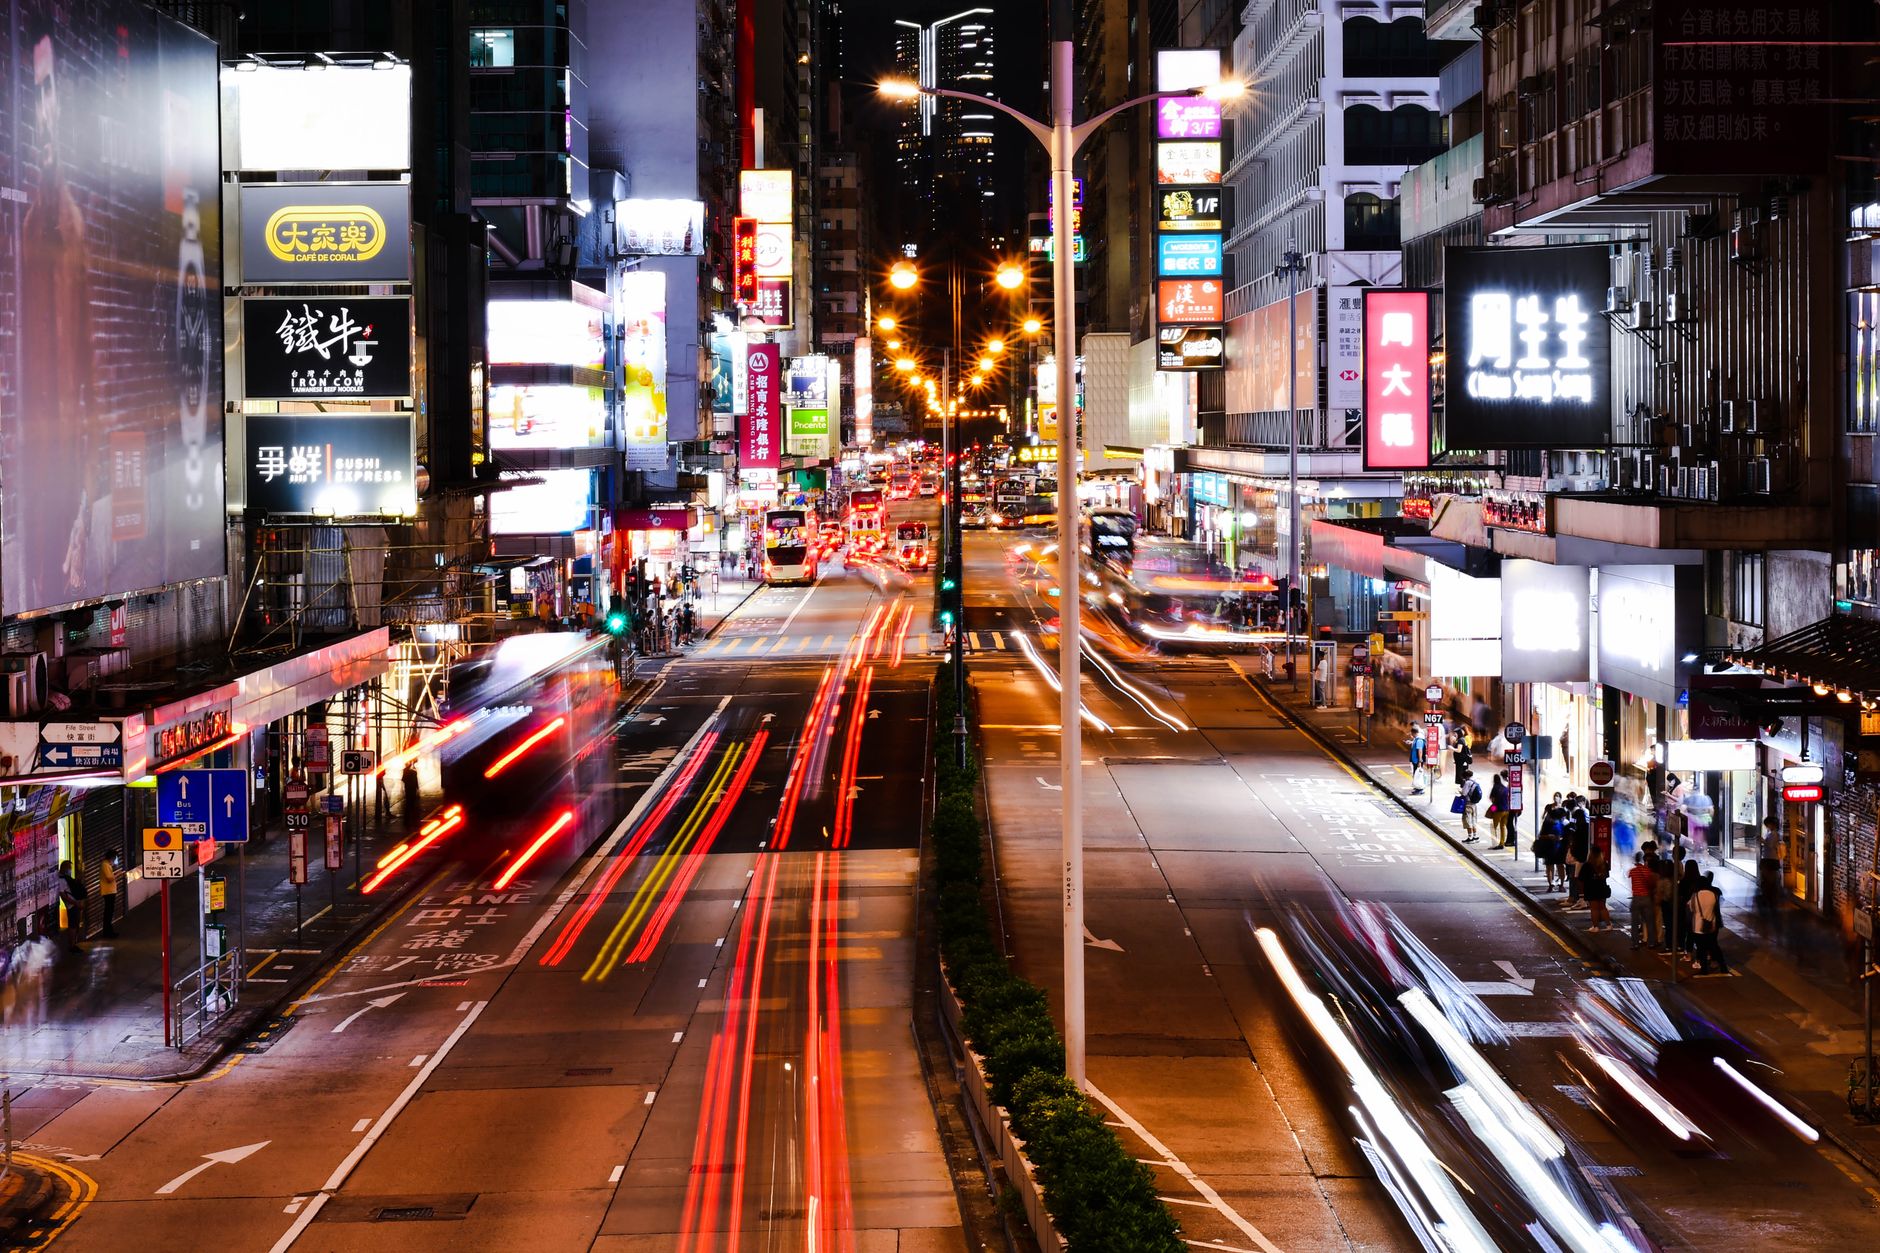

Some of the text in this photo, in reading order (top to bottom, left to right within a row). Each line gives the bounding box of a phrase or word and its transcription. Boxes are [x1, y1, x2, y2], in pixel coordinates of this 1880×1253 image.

[1196, 198, 1218, 214] 1/F
[296, 252, 357, 262] CAFÉ DE CORAL
[291, 378, 364, 386] IRON COW
[756, 375, 769, 460] 招商永隆銀行
[335, 458, 380, 470] SUSHI
[335, 470, 402, 482] EXPRESS
[1424, 714, 1442, 723] N67
[1506, 754, 1525, 763] N68
[1591, 803, 1610, 815] N69
[174, 811, 194, 820] 巴士
[287, 815, 308, 825] S10
[168, 852, 175, 861] 7
[169, 867, 181, 876] 12
[418, 893, 538, 906] LANE
[405, 908, 508, 926] 巴士
[475, 954, 499, 966] 8
